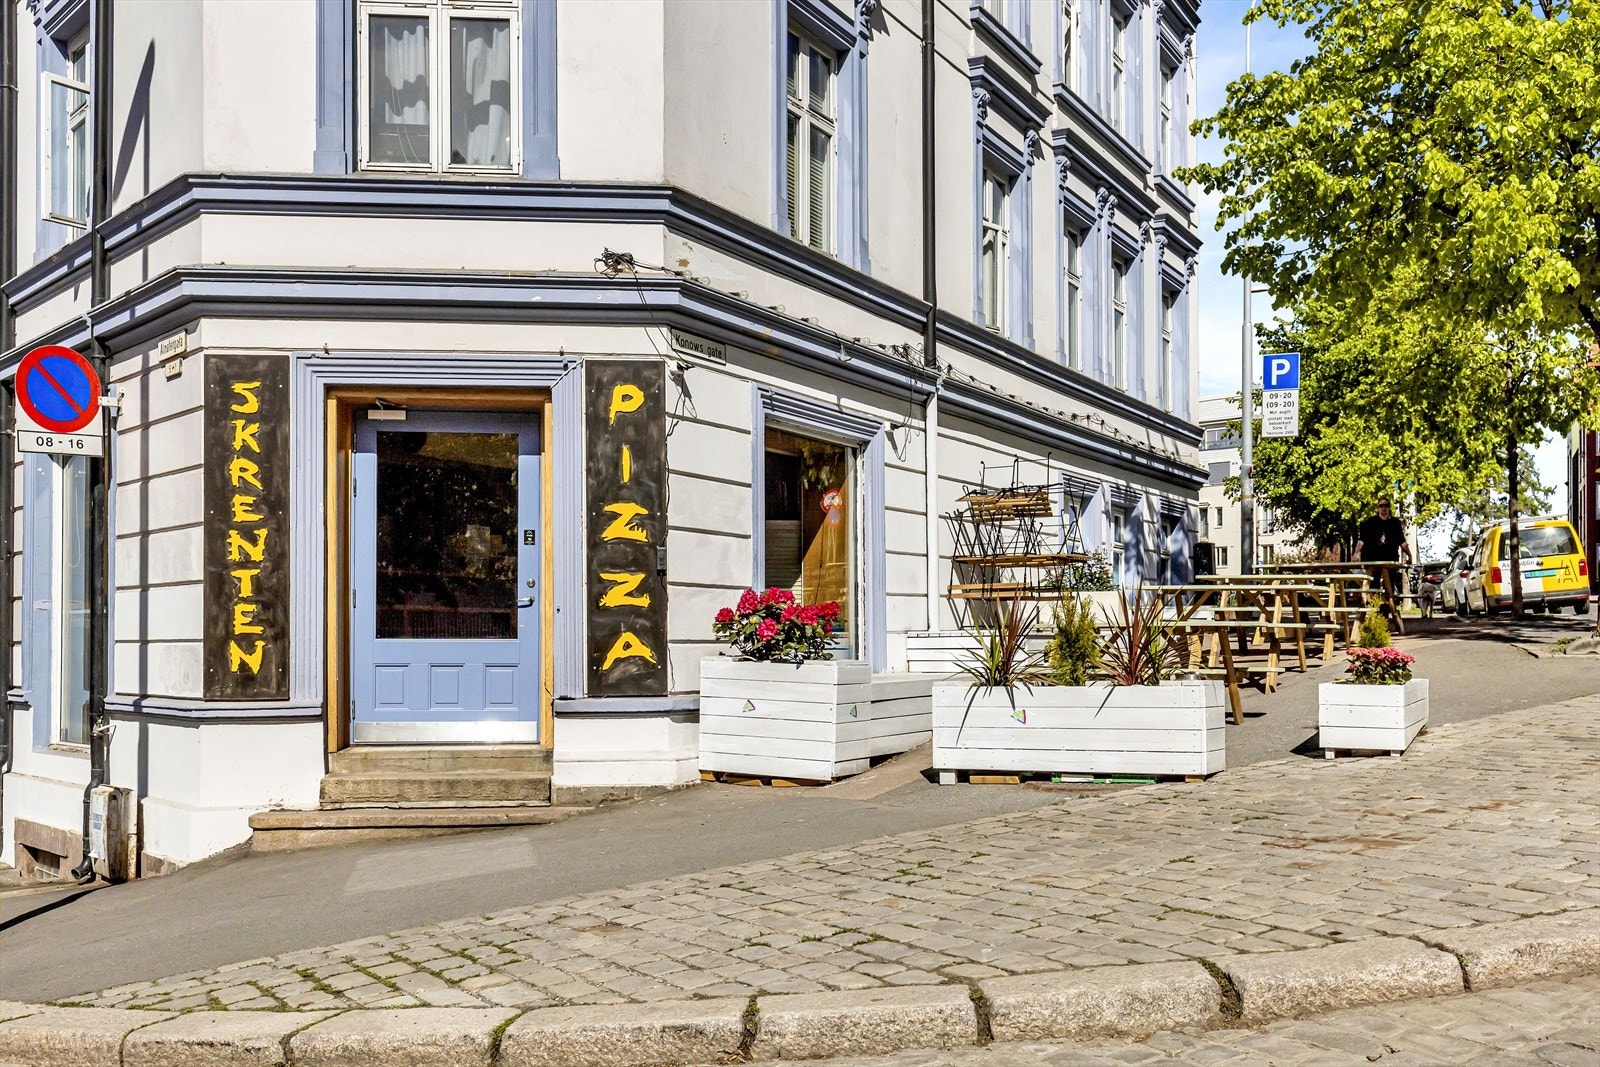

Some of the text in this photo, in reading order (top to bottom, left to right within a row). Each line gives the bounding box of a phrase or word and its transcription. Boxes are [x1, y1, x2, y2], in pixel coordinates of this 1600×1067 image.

[675, 334, 722, 358] Konows gate
[1271, 358, 1291, 386] P
[36, 436, 54, 447] 08
[68, 439, 84, 450] 16
[227, 381, 269, 675] SKRENTEN
[599, 383, 658, 671] PIZZA
